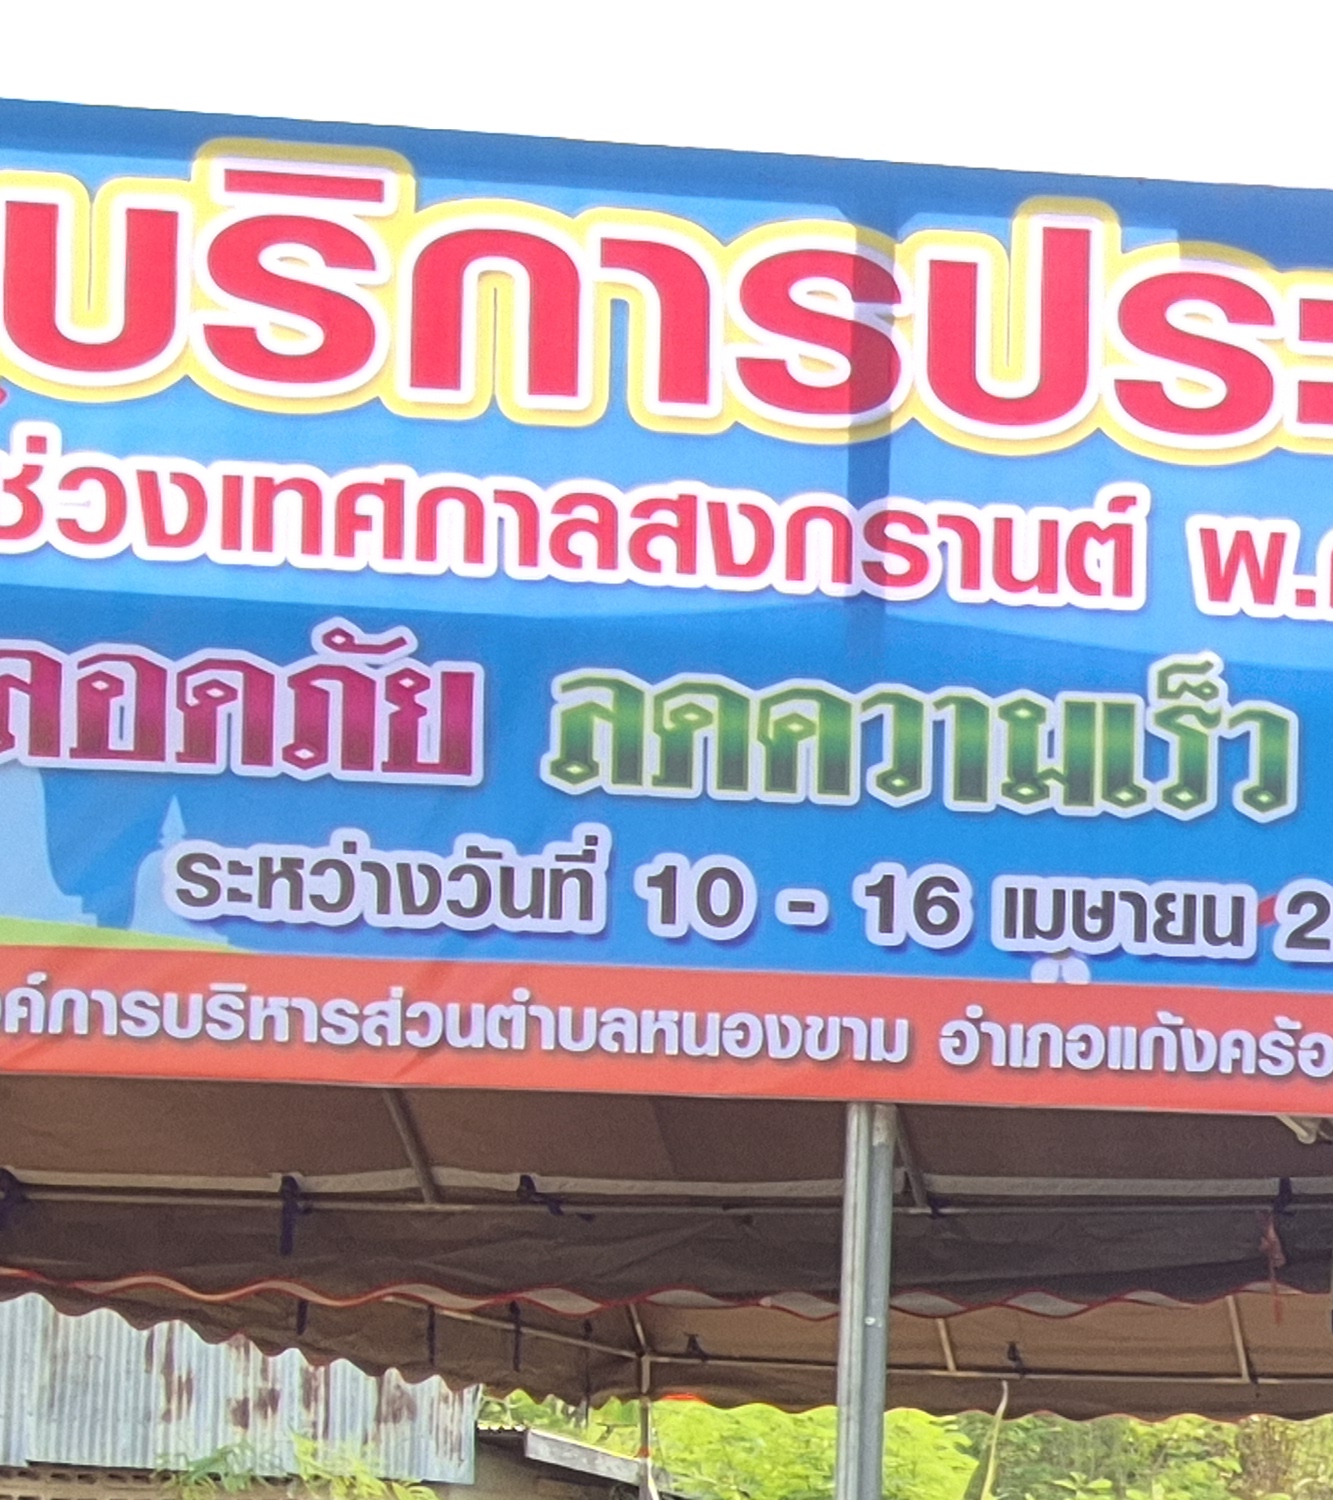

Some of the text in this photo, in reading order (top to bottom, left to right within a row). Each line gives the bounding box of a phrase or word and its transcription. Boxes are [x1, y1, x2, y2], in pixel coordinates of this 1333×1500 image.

[551, 663, 1293, 813] ลดความเร็ว
[175, 833, 604, 922] ระหว่างวันที่
[645, 864, 746, 927] 10
[864, 873, 962, 936] 16
[1003, 886, 1246, 948] เมษายน
[0, 971, 909, 1064] ค์การบริหารส่วนตำบลหนองขาม
